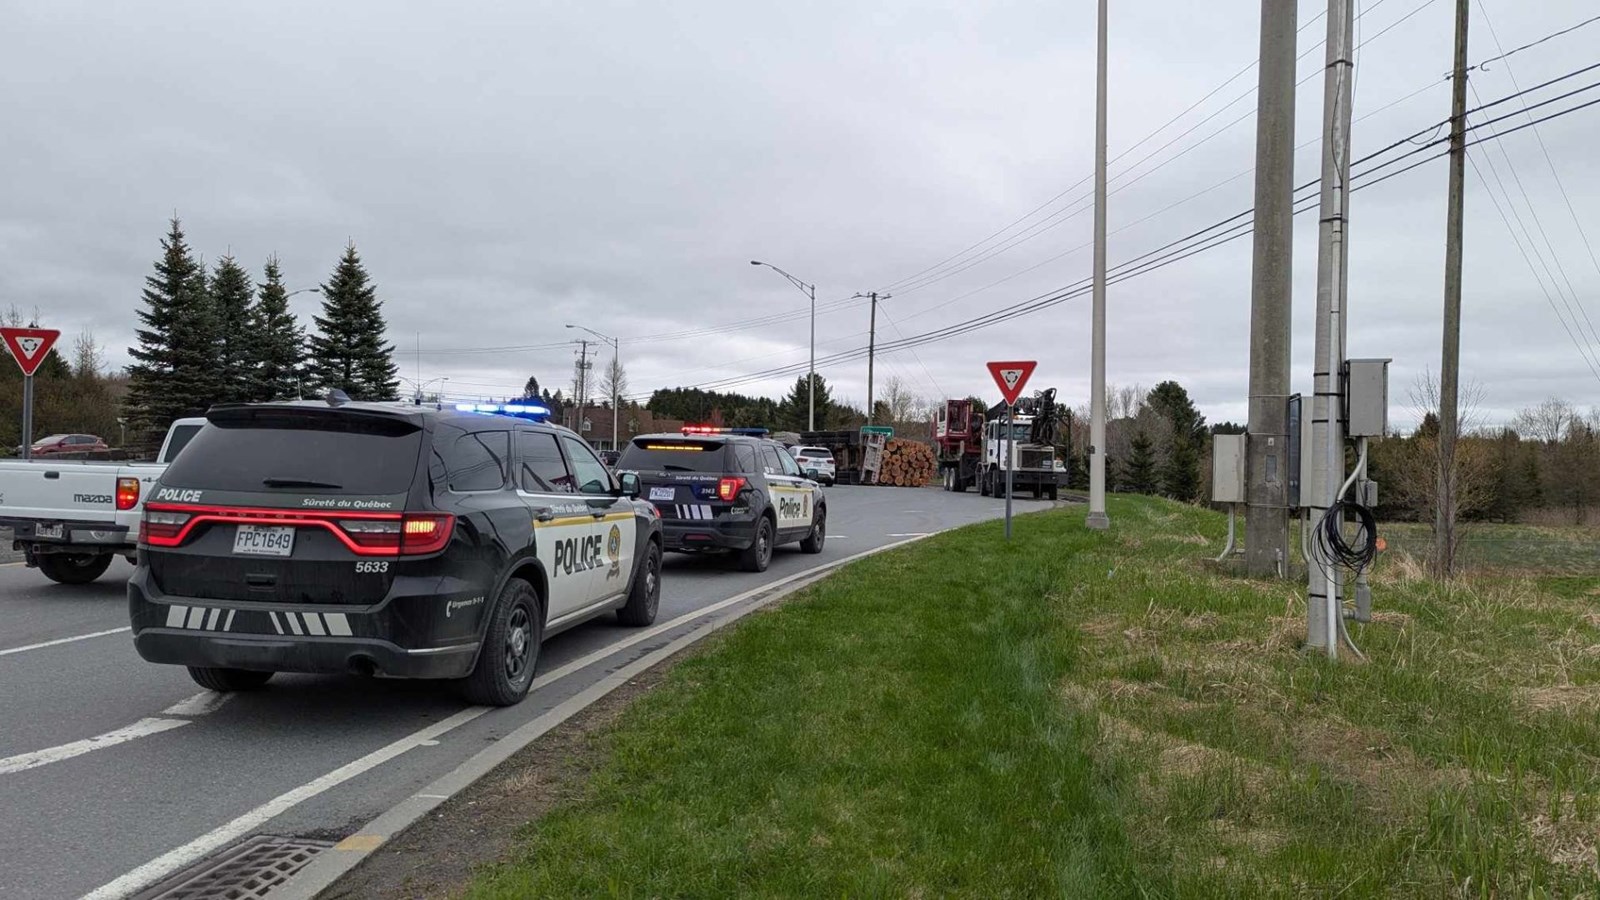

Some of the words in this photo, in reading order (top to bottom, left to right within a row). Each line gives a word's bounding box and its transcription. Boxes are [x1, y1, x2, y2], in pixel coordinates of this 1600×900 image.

[156, 488, 203, 503] POLICE
[302, 498, 336, 508] Sûreté
[337, 499, 351, 508] du
[353, 500, 392, 509] Québec
[780, 497, 801, 519] Police
[236, 531, 292, 549] FPC1649
[553, 534, 604, 578] POLICE
[355, 561, 389, 573] 5633
